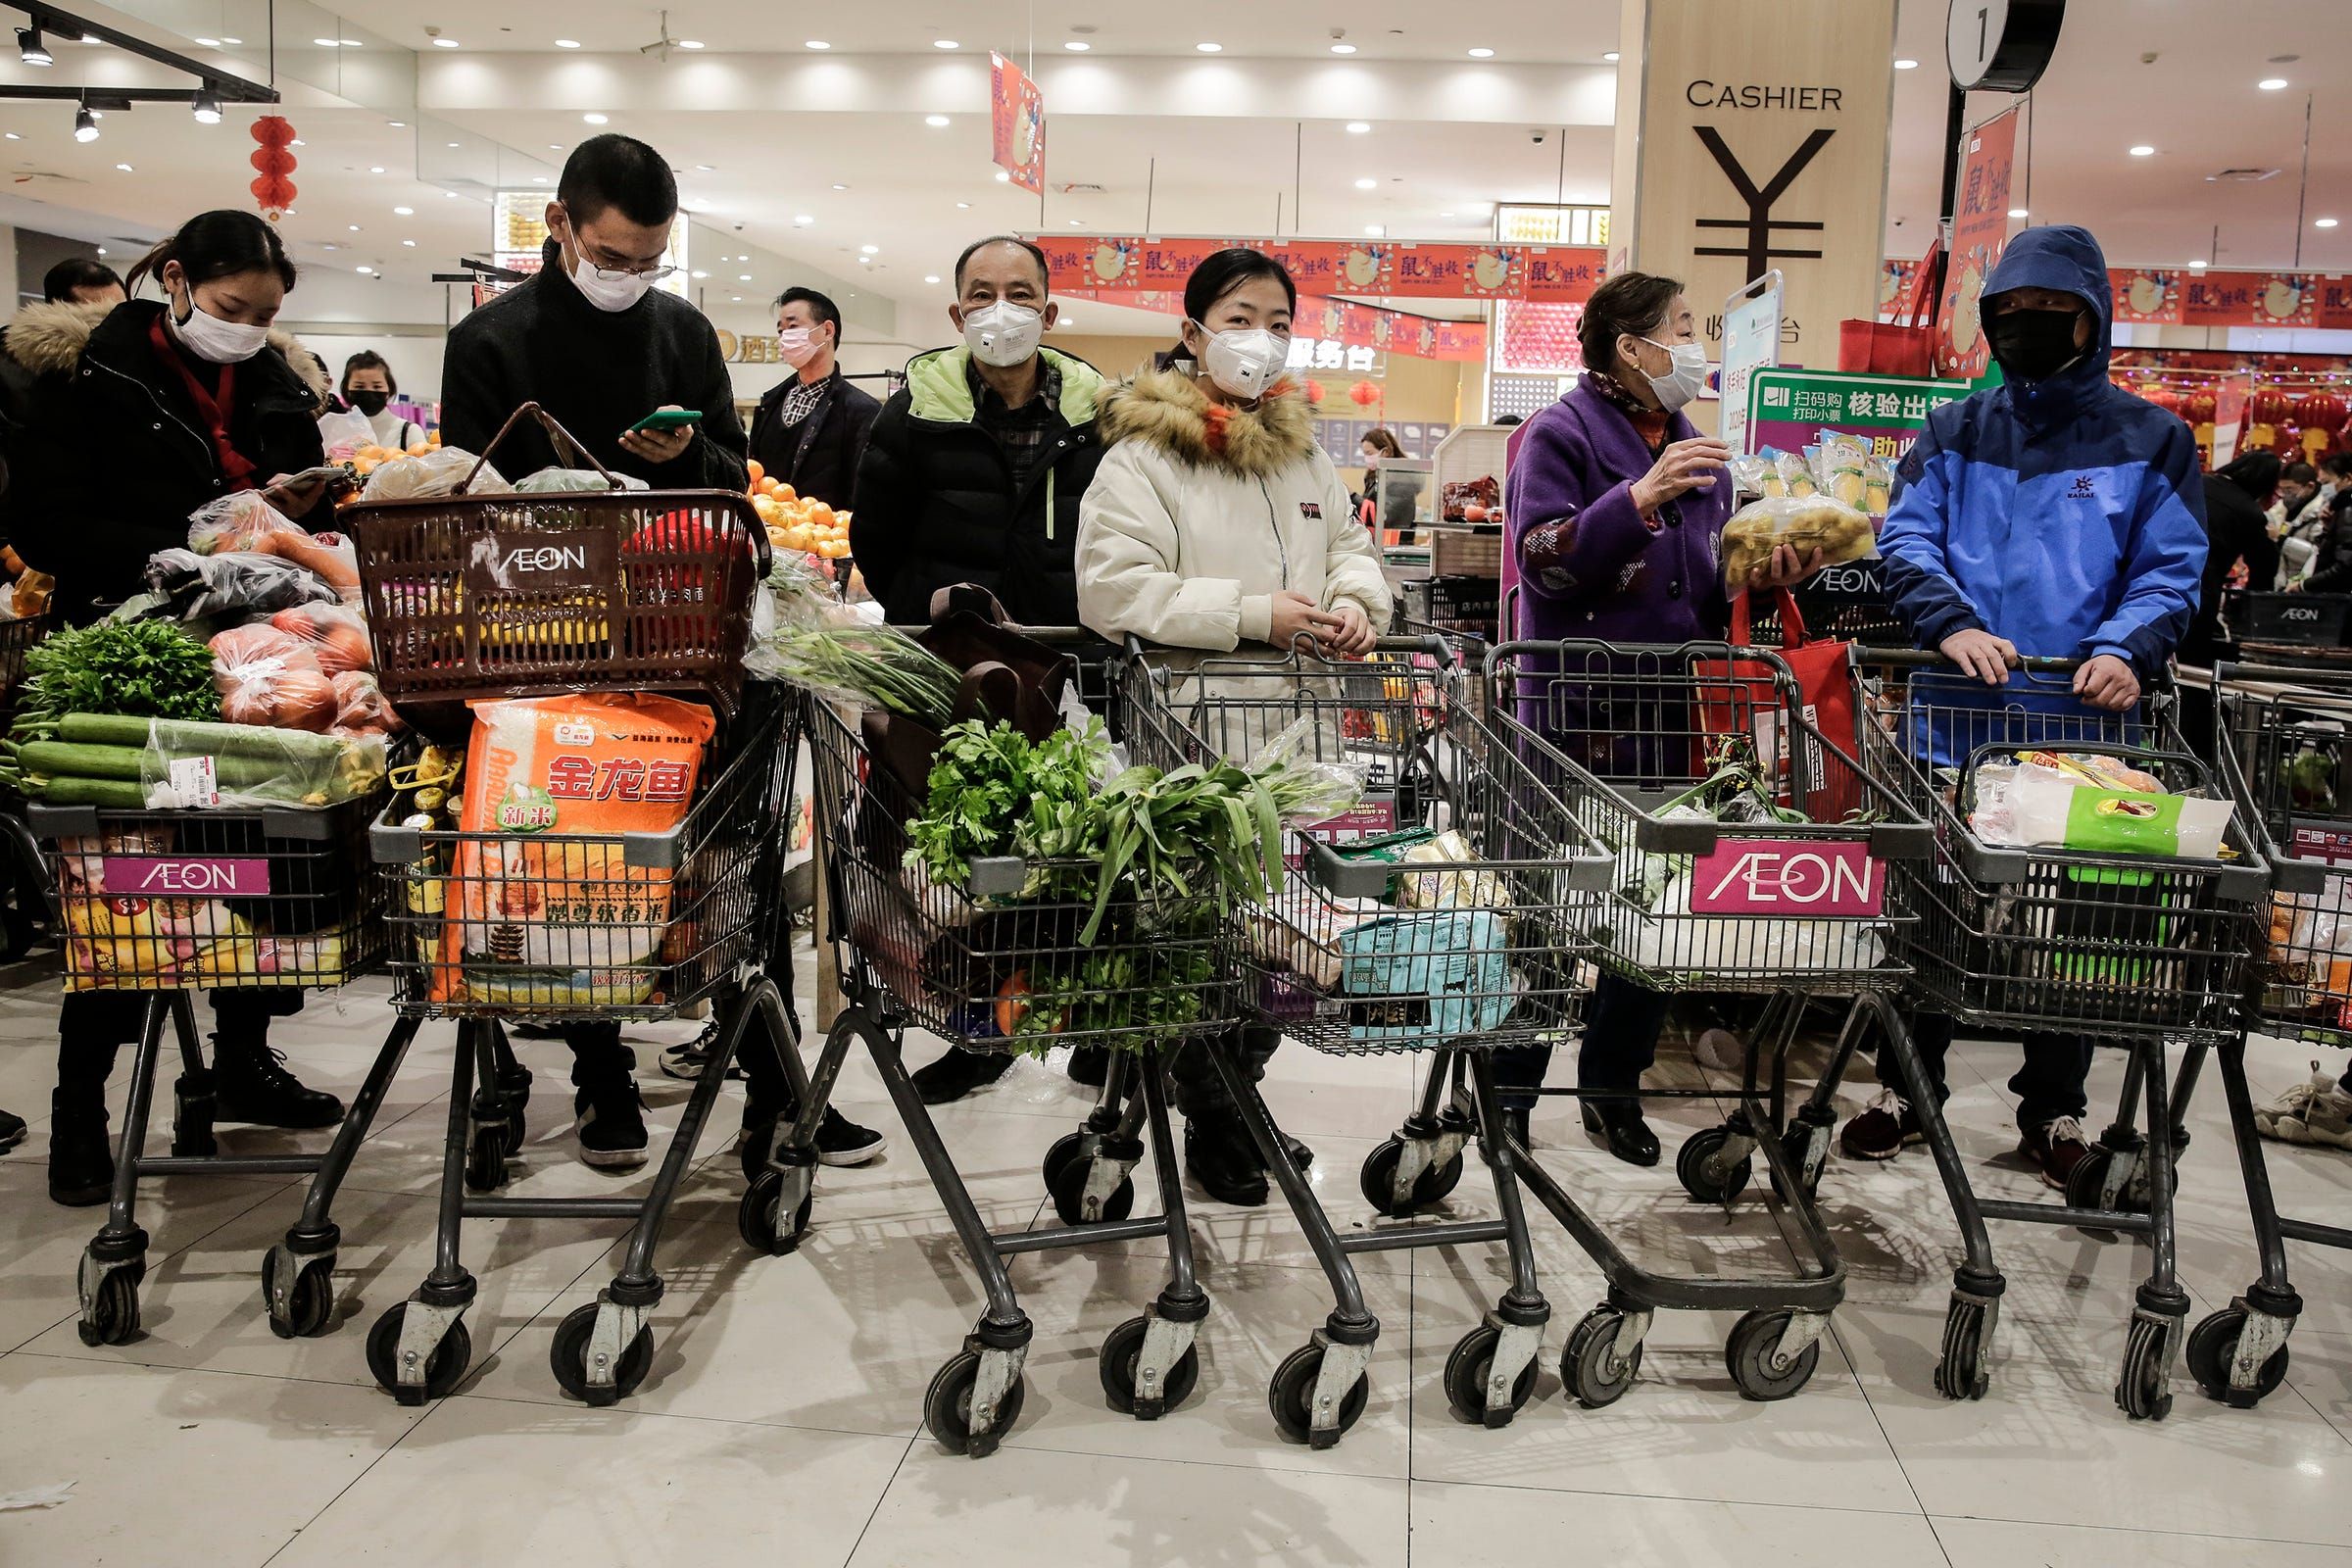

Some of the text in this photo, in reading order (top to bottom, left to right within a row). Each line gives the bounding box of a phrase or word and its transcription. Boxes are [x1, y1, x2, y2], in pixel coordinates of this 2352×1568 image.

[1979, 8, 1987, 63] 1
[1687, 80, 1842, 111] CASHIER
[1706, 314, 1801, 344] 收台
[1792, 407, 1841, 422] 打印小票
[1794, 390, 1842, 409] 扫码购
[547, 754, 690, 803] 金龙鱼
[503, 805, 553, 827] 新米
